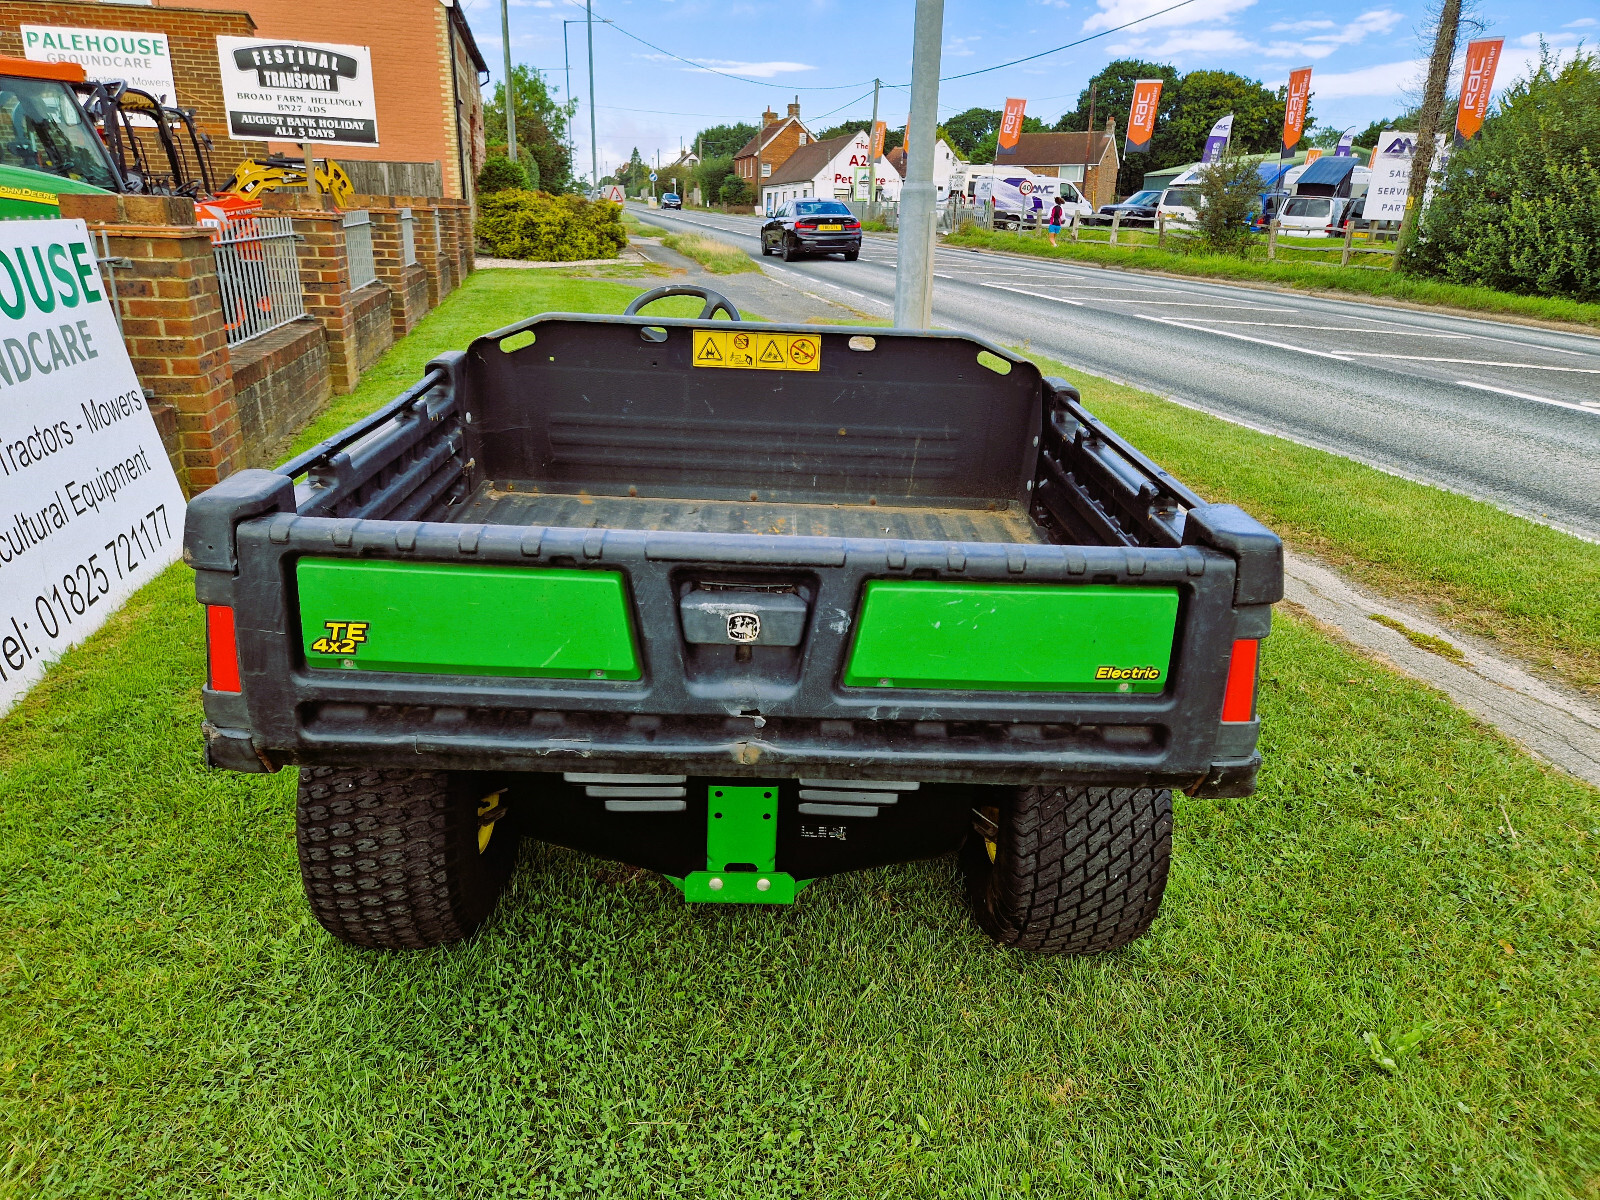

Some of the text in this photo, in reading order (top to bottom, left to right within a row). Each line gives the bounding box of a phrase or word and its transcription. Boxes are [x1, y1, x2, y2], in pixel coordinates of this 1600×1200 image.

[25, 31, 165, 57] PALEHOUSE
[46, 53, 152, 69] GROUNDCARE
[251, 49, 339, 72] FESTIVAL
[131, 76, 171, 88] Mowers
[263, 71, 331, 90] TRANSPORT
[1474, 46, 1496, 118] Approved Dealer
[237, 92, 273, 101] BROAD
[311, 97, 364, 107] HELLINGLY
[277, 104, 327, 114] BN27 4DS
[241, 114, 365, 131] AUGUST BANK HOLIDAY
[275, 127, 336, 138] ALL 3 DAYS
[849, 154, 871, 167] A2
[834, 173, 853, 184] Pet
[22, 188, 57, 200] DEERE
[1021, 184, 1031, 192] 40
[1381, 203, 1406, 212] PART
[81, 389, 143, 434] Mowers
[64, 444, 152, 516] Equipment
[35, 553, 110, 639] 01825
[104, 503, 172, 581] 721177
[325, 621, 368, 643] TE
[312, 638, 356, 654] 4x2
[1095, 666, 1160, 680] Electric
